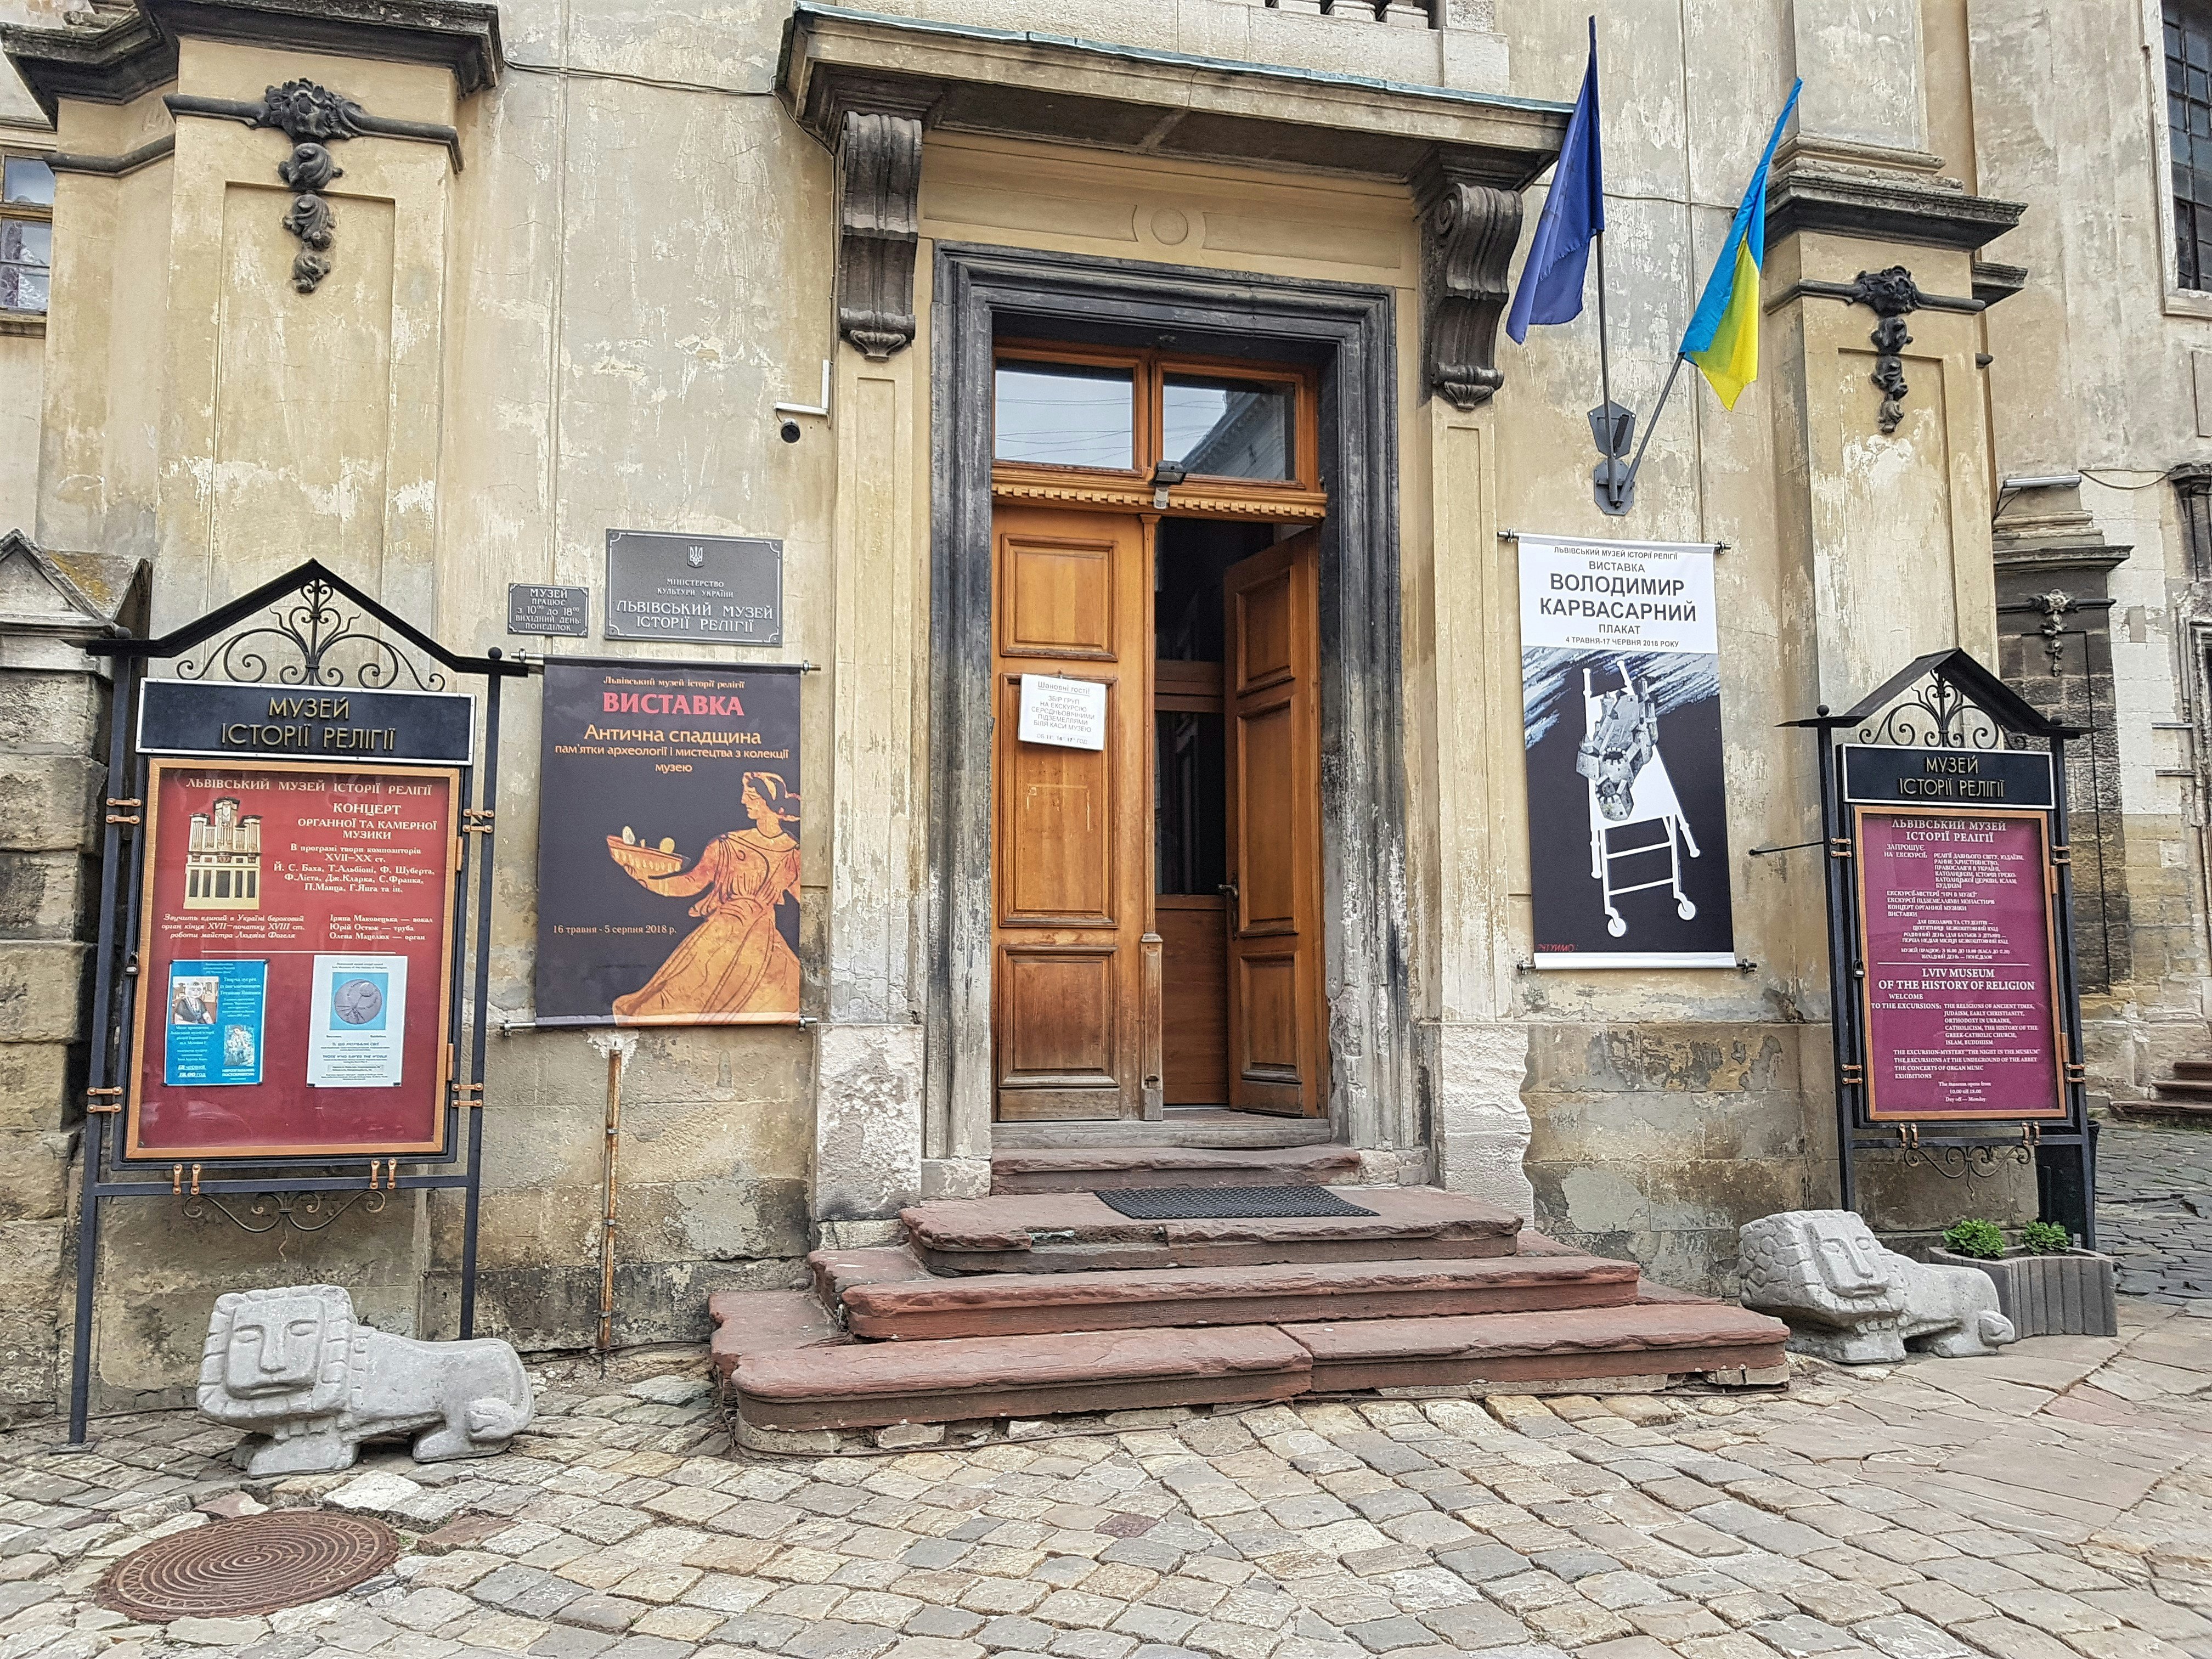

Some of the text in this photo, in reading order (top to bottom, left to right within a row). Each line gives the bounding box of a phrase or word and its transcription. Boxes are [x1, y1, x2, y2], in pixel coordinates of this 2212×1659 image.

[1554, 547, 1599, 556] ЛЬВІВСЬКИЙ
[1589, 561, 1645, 572] ВИСТАВКА
[667, 579, 724, 587] МІНІСТЕРСТВО
[1551, 573, 1684, 597] ВОЛОДИМИР
[531, 589, 568, 600] МУЗЕЙ
[617, 601, 772, 619] ЛЬВІВСЬКИЙ МУЗЕЙ
[1541, 598, 1696, 621] КАРВАСАРНИЙ
[515, 613, 554, 623] ВИХІДНИЙ
[526, 623, 571, 631] ПОНЕДІЛОК
[637, 616, 753, 632] ІСТОРІЇ РЕЛІГІЇ
[1599, 624, 1640, 634] ПЛАКАТ
[603, 676, 744, 689] Львівський музей історії релігії
[1038, 681, 1090, 695] Шановні гості!
[269, 696, 348, 718] МУЗЕЙ
[603, 692, 744, 715] ВИСТАВКА
[1051, 703, 1087, 712] ЕКСКУРСІЮ
[1038, 714, 1088, 725] ПІДЗЕМЕЛЛЯМИ
[1069, 724, 1091, 732] МУЗЕЮ
[222, 723, 396, 749] ІСТОРІЇ РЕЛІГІЇ
[584, 725, 761, 746] Антична спадщина
[556, 744, 604, 754] пам'ятки
[607, 747, 667, 757] археології
[670, 747, 672, 755] і
[676, 749, 732, 758] мистецтва
[744, 749, 788, 760] колекції
[656, 764, 692, 774] музею
[1926, 755, 1978, 774] МУЗЕЙ
[186, 778, 432, 795] ЛЬВІВСЬКИЙ МУЗЕЙ ІСТОРІЇ РЕЛІГІЇ
[1900, 778, 2004, 797] ІСТОРІЇ РЕЛІГІЇ
[334, 803, 402, 816] КОНЦЕРТ
[298, 818, 437, 830] ОРГАННОЇ ТА КАМЕРНОЇ
[1892, 820, 2006, 831] ЛЬВІВСЬКИЙ МУЗЕЙ
[343, 831, 391, 839] МУЗИКИ
[1906, 831, 1994, 842] ІСТОРІЇ РЕЛІГІЇ
[274, 861, 284, 871] Й.
[302, 864, 324, 872] Баха,
[163, 913, 198, 922] Звучить
[554, 925, 563, 933] 16
[566, 927, 596, 935] травня
[646, 925, 667, 933] 2018
[1922, 968, 1995, 977] LVIV MUSEUM
[1878, 980, 2035, 990] OF THE HISTORY OF RELIGION
